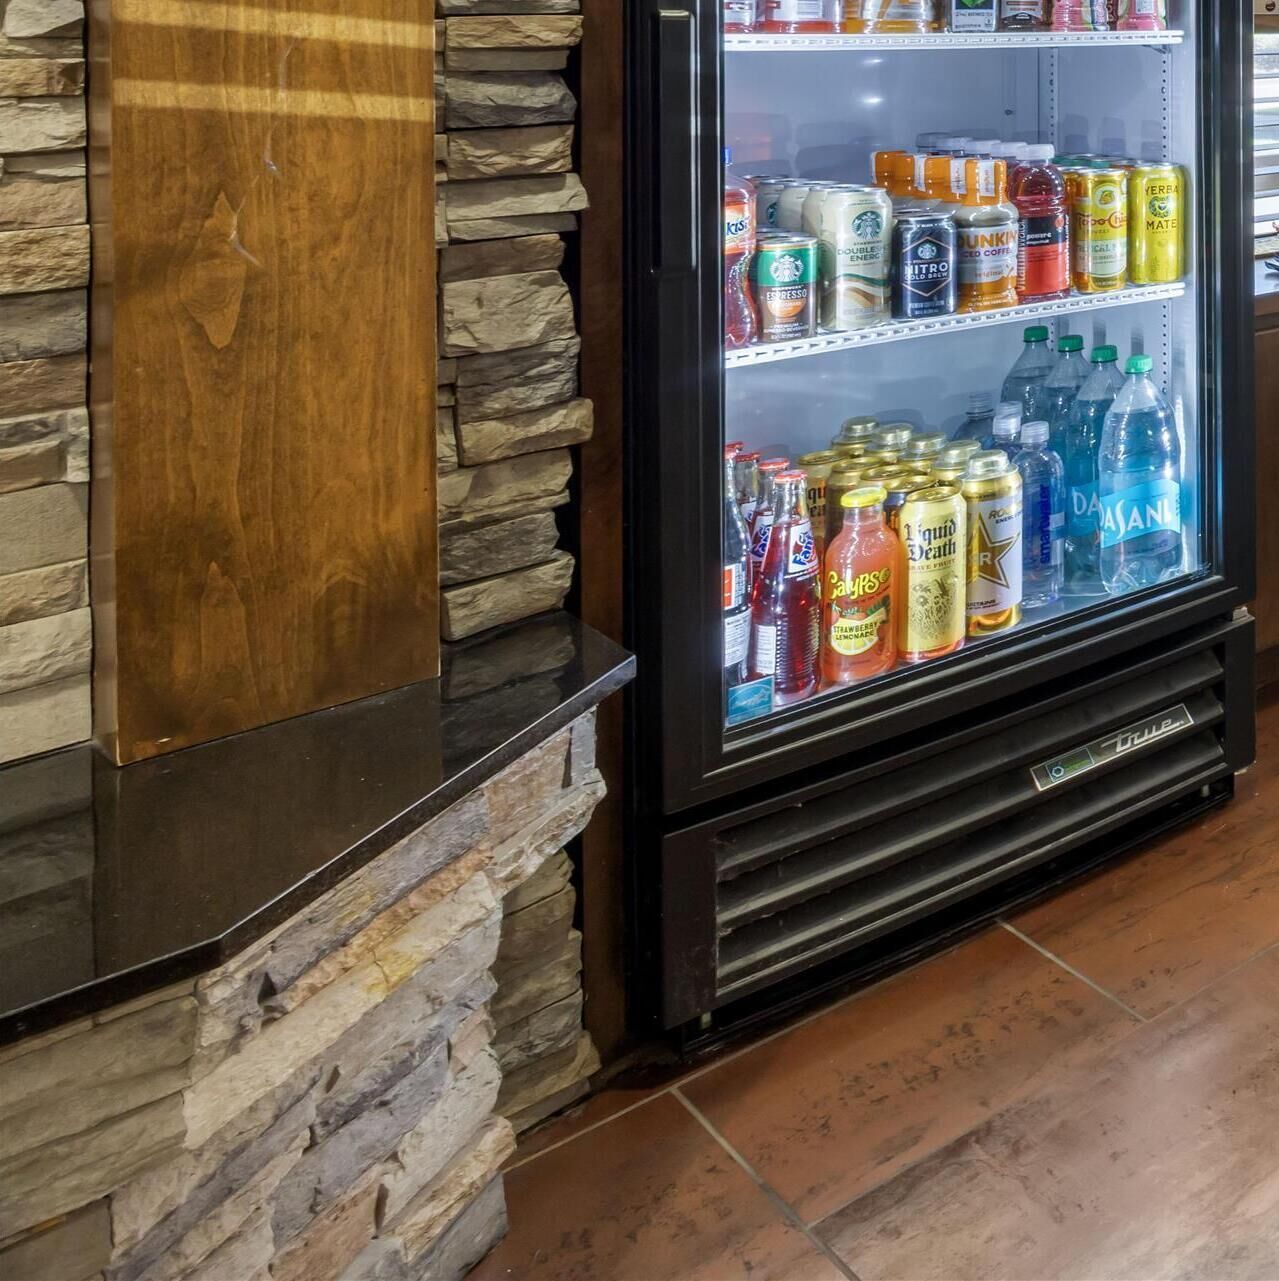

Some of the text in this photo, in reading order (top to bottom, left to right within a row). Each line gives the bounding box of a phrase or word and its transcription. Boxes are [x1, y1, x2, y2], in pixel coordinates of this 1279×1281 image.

[1144, 184, 1178, 195] YERBA
[1146, 219, 1177, 230] MATE
[904, 262, 949, 275] NITRO
[767, 288, 807, 302] ESPRESSO
[904, 518, 956, 545] Liquid
[908, 537, 957, 562] Death
[833, 621, 879, 634] STRAWBERRY
[835, 629, 875, 641] LEMONADE
